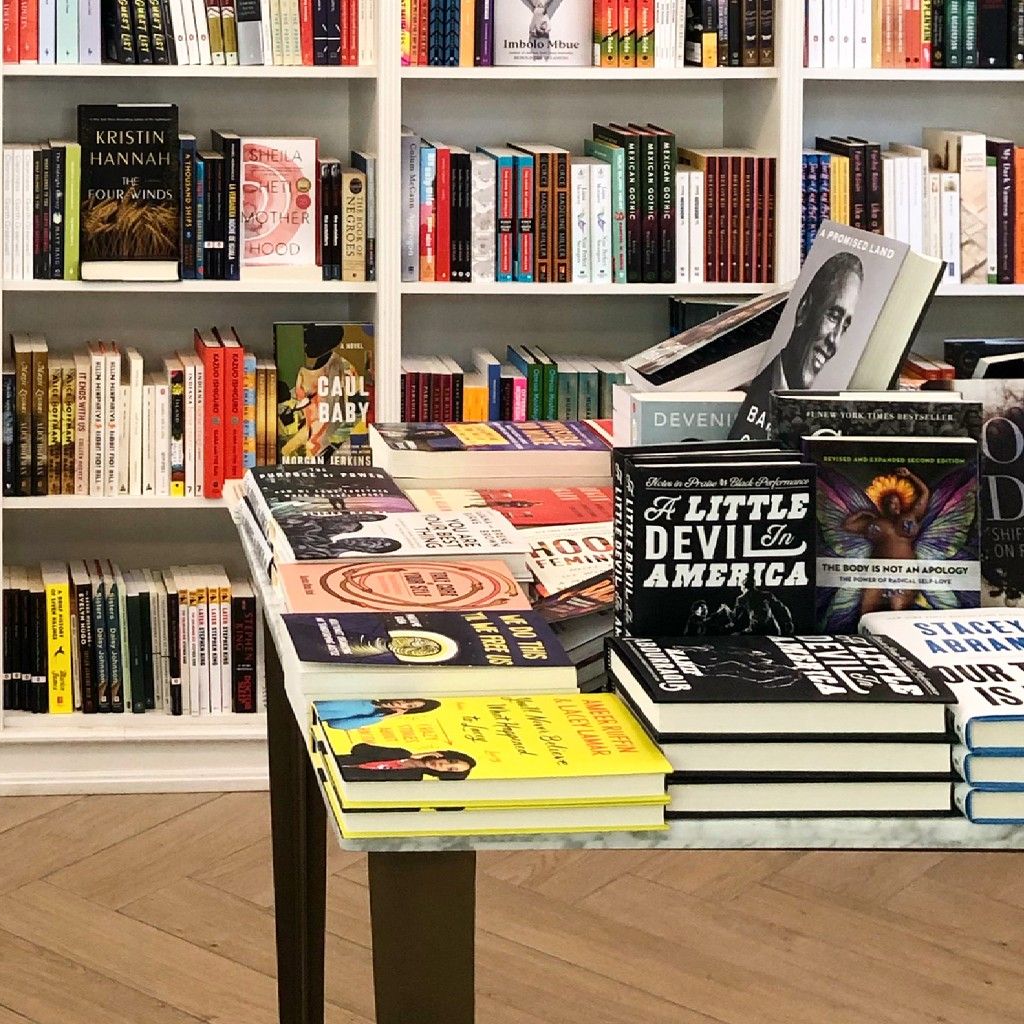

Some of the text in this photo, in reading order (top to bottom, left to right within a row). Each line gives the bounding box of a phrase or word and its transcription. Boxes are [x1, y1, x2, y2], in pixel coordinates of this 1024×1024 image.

[121, 34, 132, 52] LIST
[503, 39, 580, 50] Imbolo Mbue
[95, 130, 165, 144] KRISTIN
[90, 151, 171, 166] HANNAH
[248, 149, 303, 162] SHEILA
[122, 177, 140, 187] THE
[259, 181, 292, 193] HETI
[88, 189, 173, 200] FOUR WINDS
[345, 195, 356, 257] NEGROES
[249, 242, 300, 256] HOOD
[819, 229, 895, 260] A PROMISED LAND
[317, 375, 370, 398] CAUL
[78, 372, 87, 432] IT ENDS WITH US
[318, 402, 370, 424] BABY
[867, 412, 895, 420] TIMES
[282, 455, 371, 467] MORGAN JERKINS
[645, 477, 672, 488] Notes
[684, 477, 717, 488] Praise
[643, 493, 810, 521] A LITTLE
[645, 524, 807, 560] DEVIL
[760, 524, 794, 546] In
[643, 562, 809, 588] AMERICA
[822, 564, 968, 575] THE BODY IS NOT AN APOLOGY
[78, 593, 86, 621] EVELYN
[235, 622, 245, 651] KING
[244, 612, 254, 661] STEPHEN
[510, 625, 537, 639] DO
[913, 620, 1024, 636] STACEY
[519, 640, 548, 660] THIS
[930, 663, 1016, 683] OUR
[973, 686, 1023, 705] IS
[603, 725, 638, 754] RUFFIN
